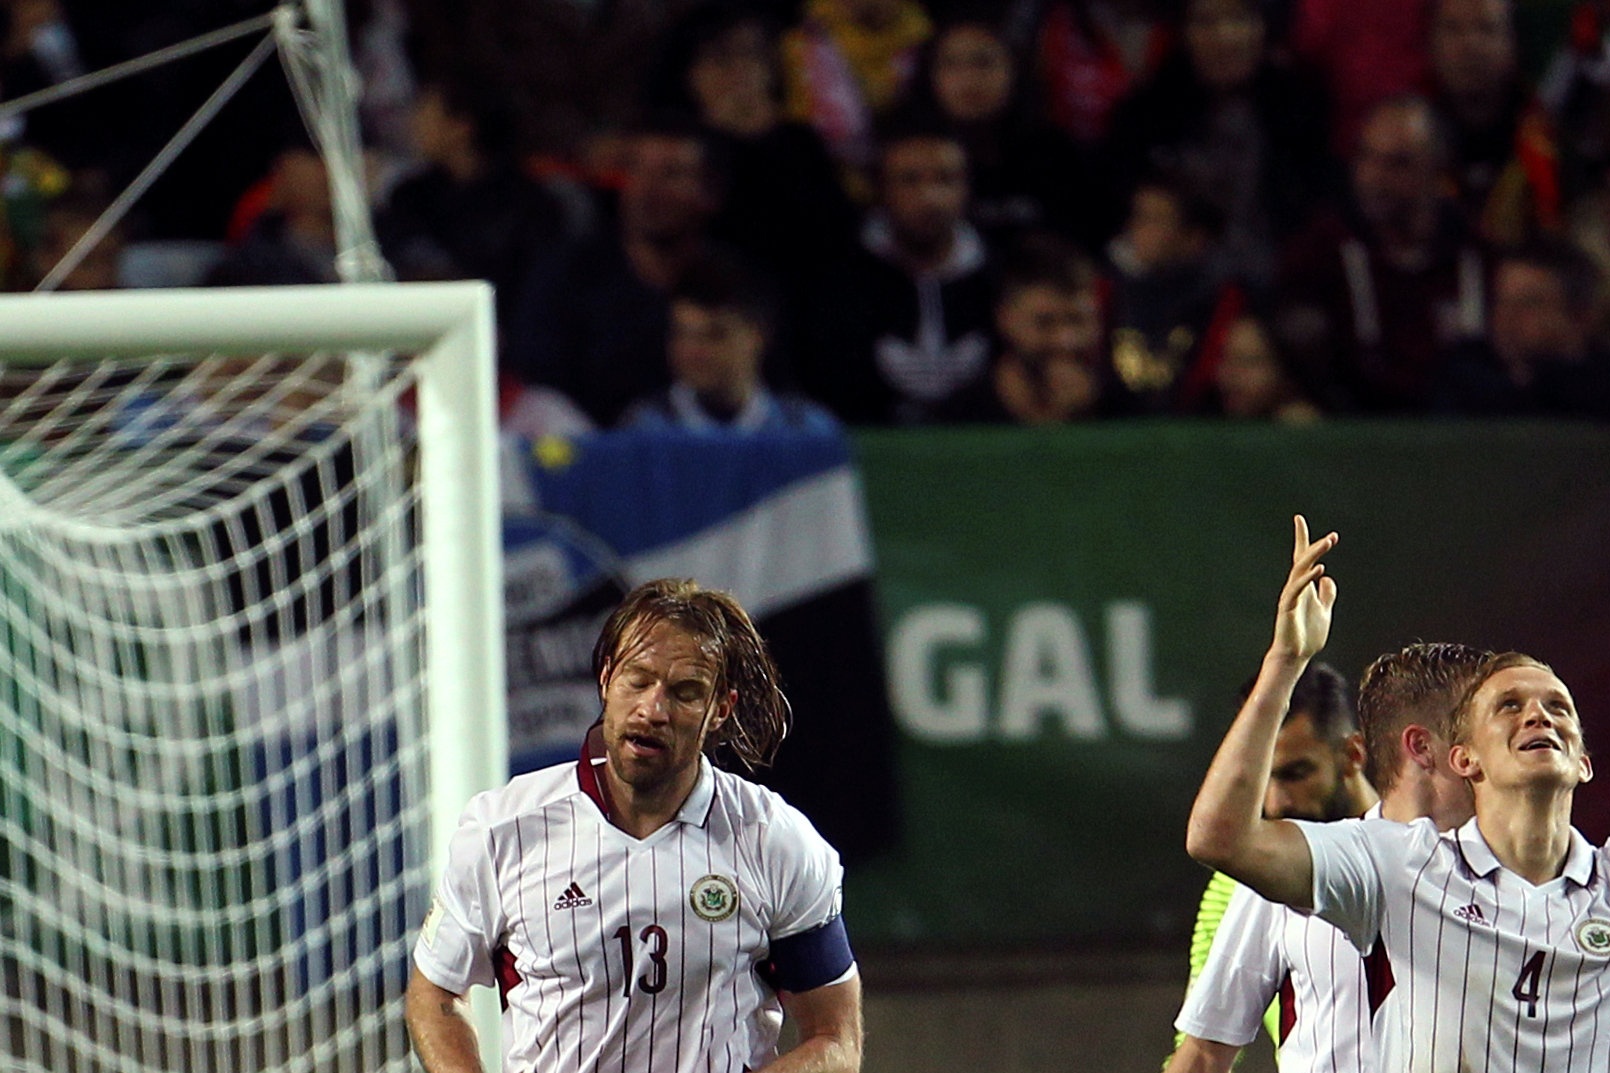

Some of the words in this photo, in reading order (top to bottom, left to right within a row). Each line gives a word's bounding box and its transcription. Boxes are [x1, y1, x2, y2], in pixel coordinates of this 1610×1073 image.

[553, 897, 592, 910] adidas
[613, 924, 668, 998] 13
[1512, 949, 1547, 1019] 4
